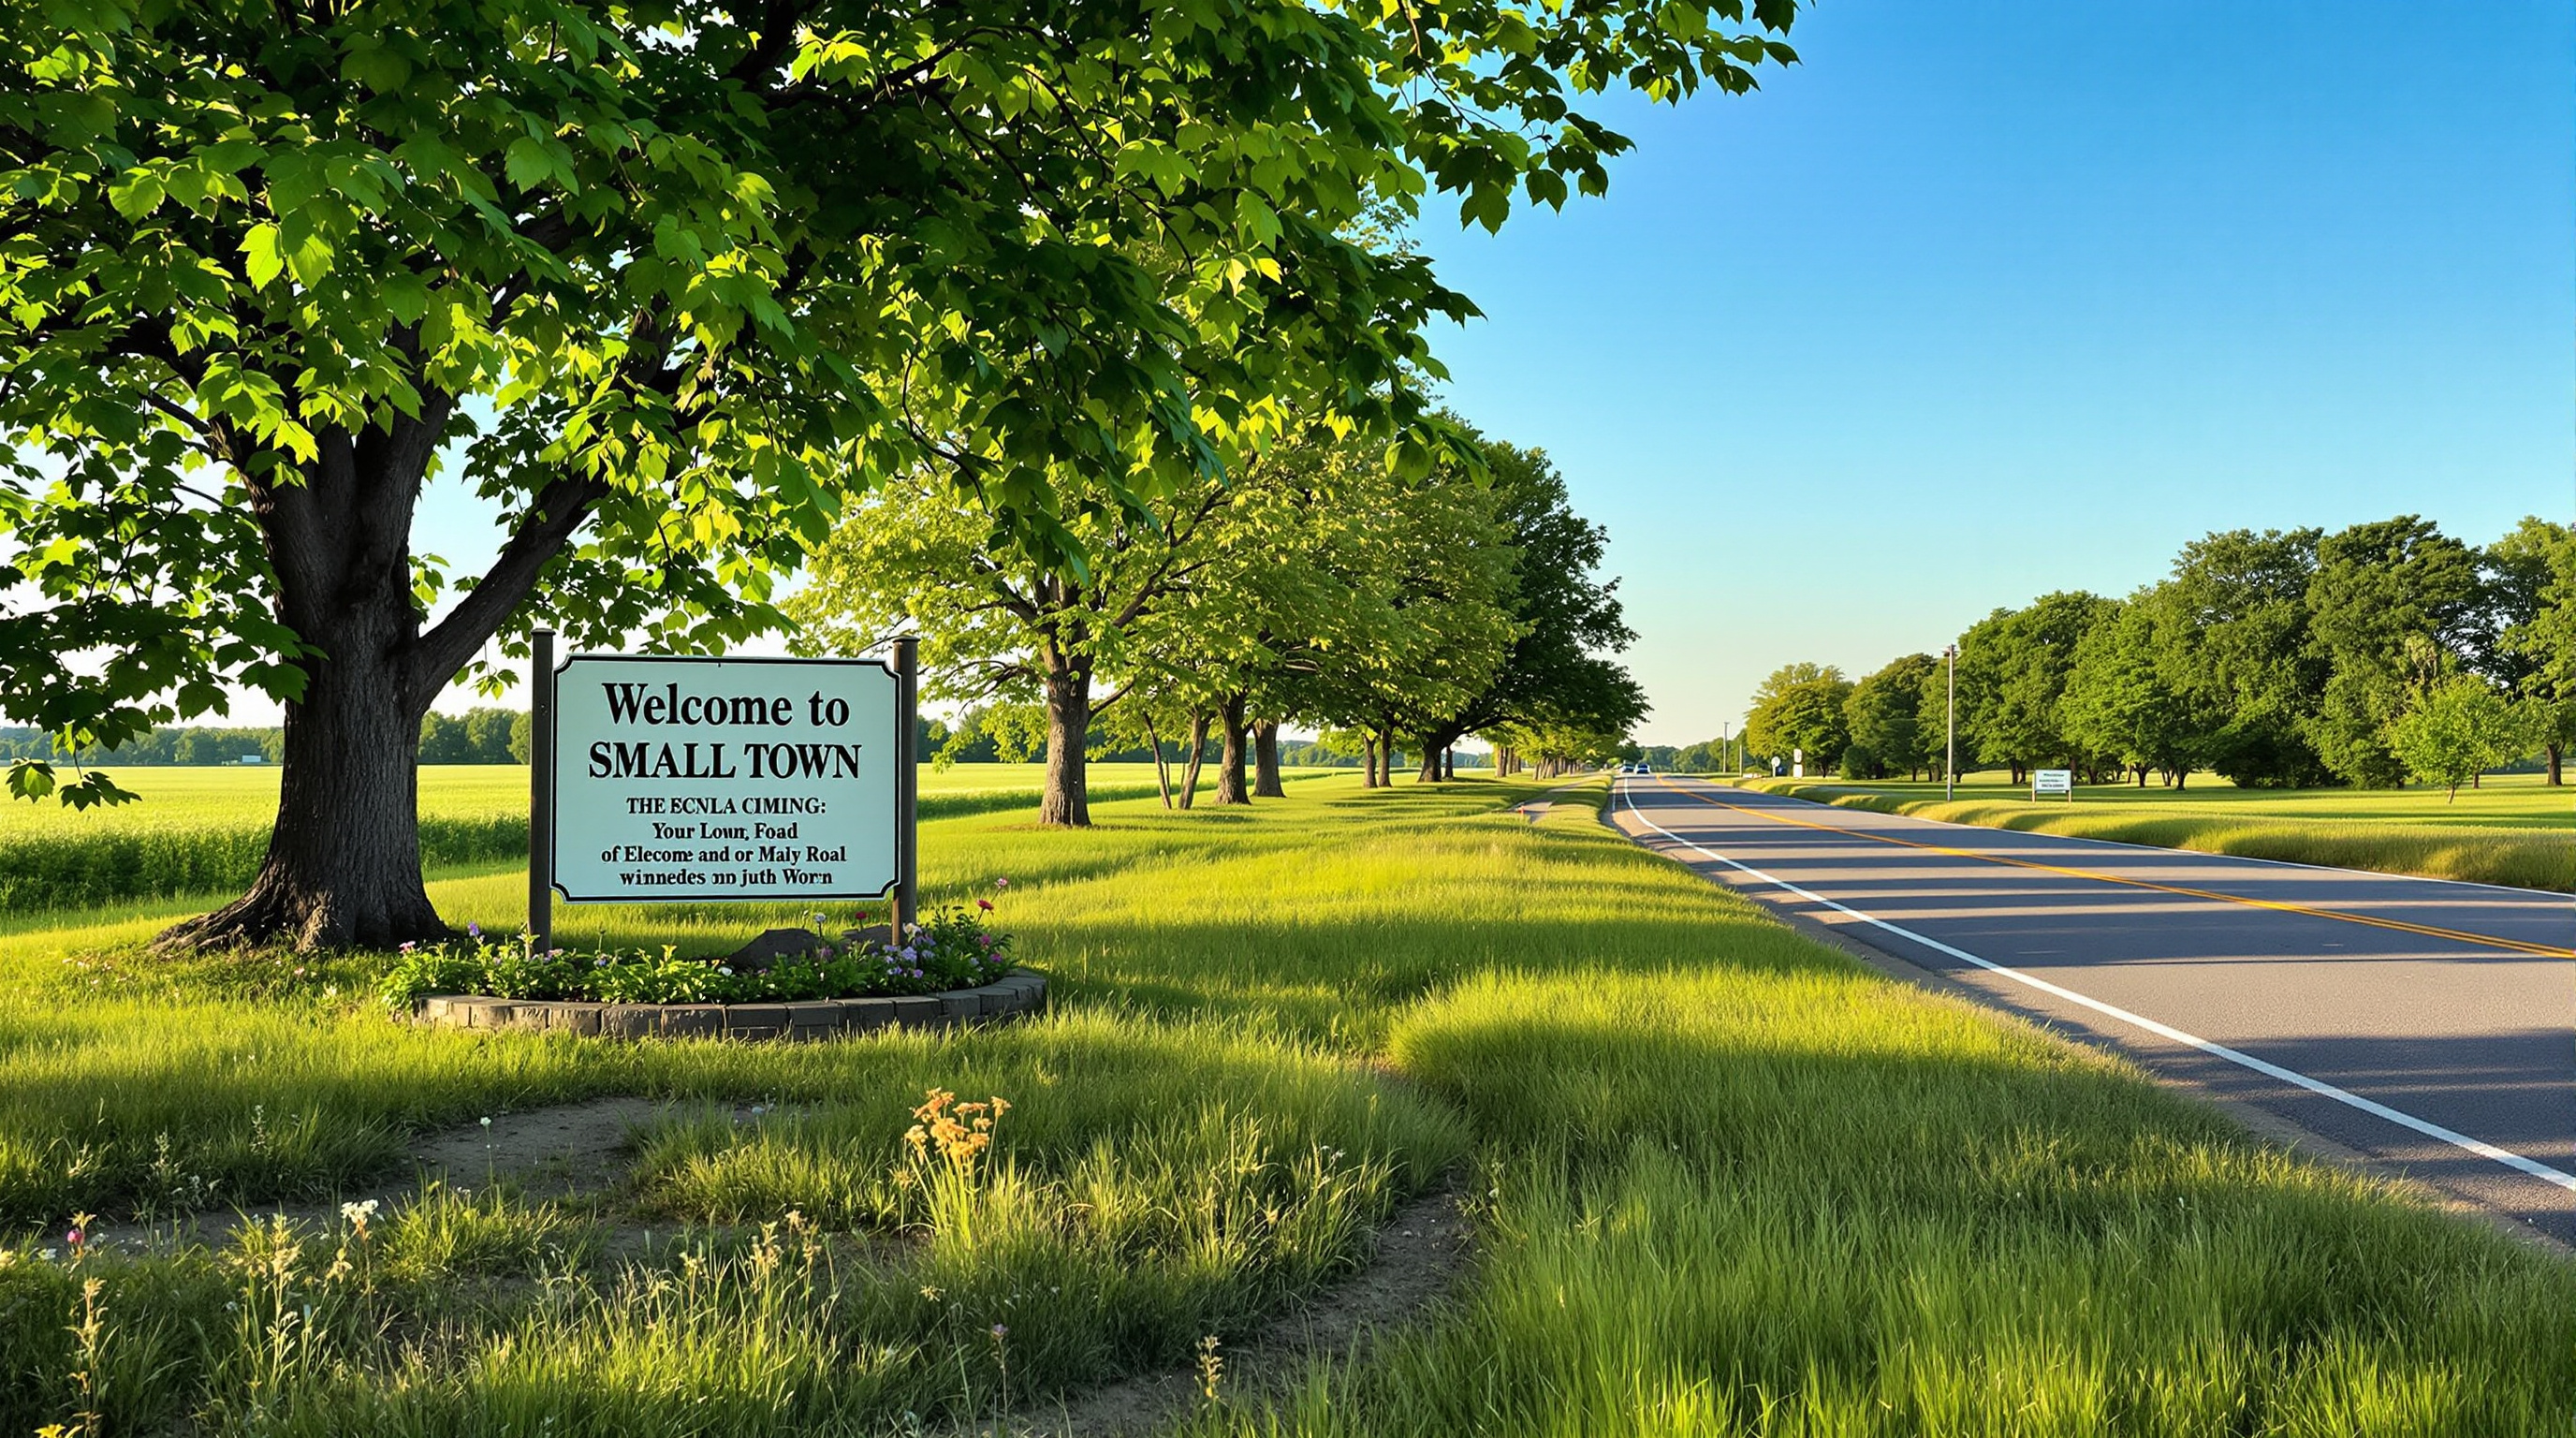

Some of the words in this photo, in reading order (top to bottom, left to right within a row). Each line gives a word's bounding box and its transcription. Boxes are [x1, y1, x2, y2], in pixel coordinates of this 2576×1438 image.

[601, 682, 793, 726] Welcome
[809, 690, 850, 726] to
[589, 741, 736, 779] SMALL
[744, 742, 862, 780] TOWN
[626, 797, 666, 814] THE
[652, 822, 695, 840] Your
[754, 822, 798, 840] Foad
[601, 844, 622, 862] of
[698, 845, 731, 862] and
[735, 850, 754, 862] or
[758, 845, 801, 866] Maly
[806, 845, 847, 863] Roal
[619, 868, 707, 886] winnedes
[739, 868, 777, 888] juth
